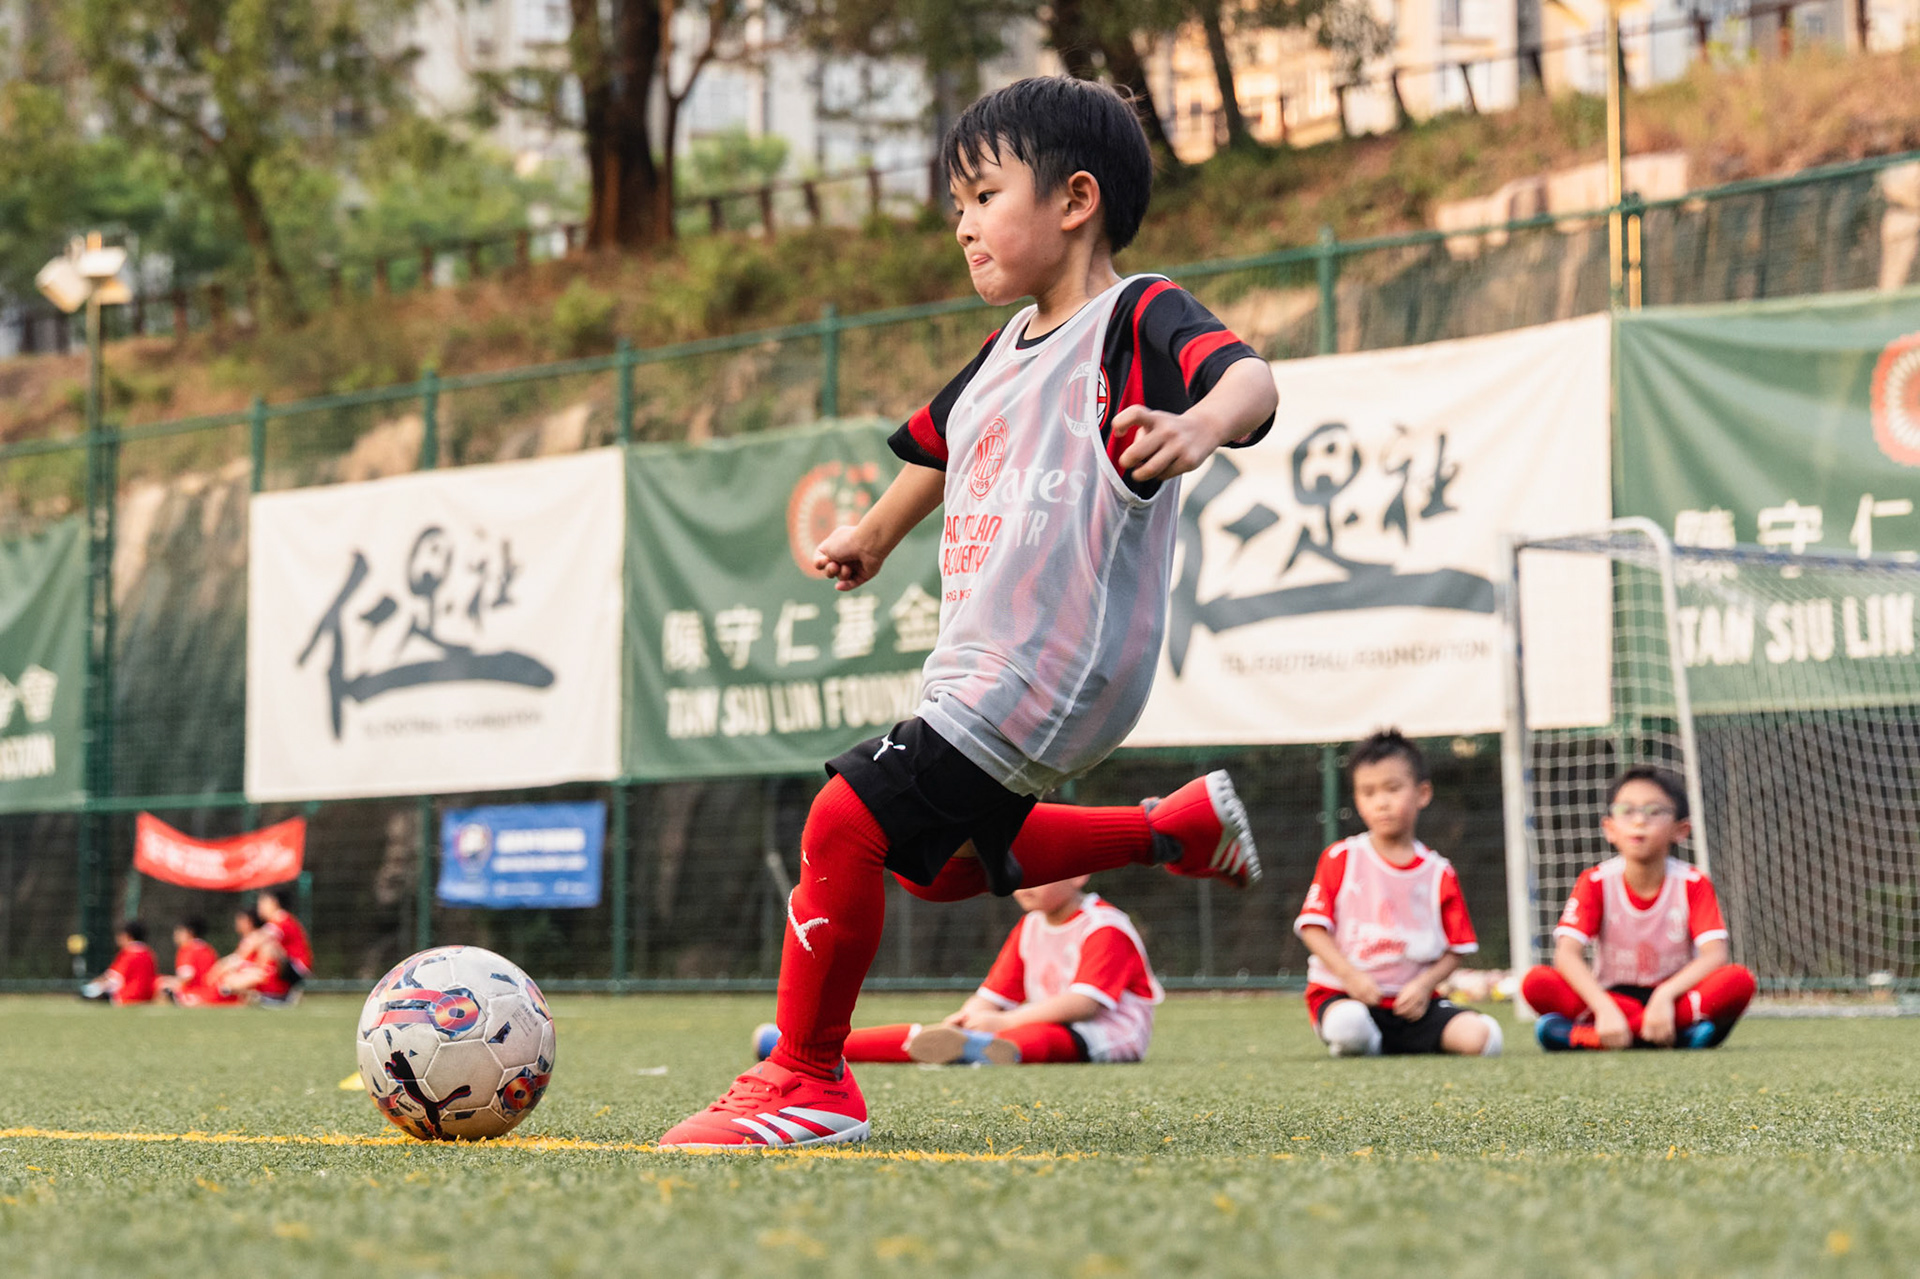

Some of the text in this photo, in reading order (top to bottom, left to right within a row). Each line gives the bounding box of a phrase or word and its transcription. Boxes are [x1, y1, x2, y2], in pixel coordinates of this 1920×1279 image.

[973, 479, 989, 490] 1899
[944, 515, 960, 543] AC
[963, 513, 1003, 543] MLAN
[1678, 592, 1915, 667] TAN SIU LIN
